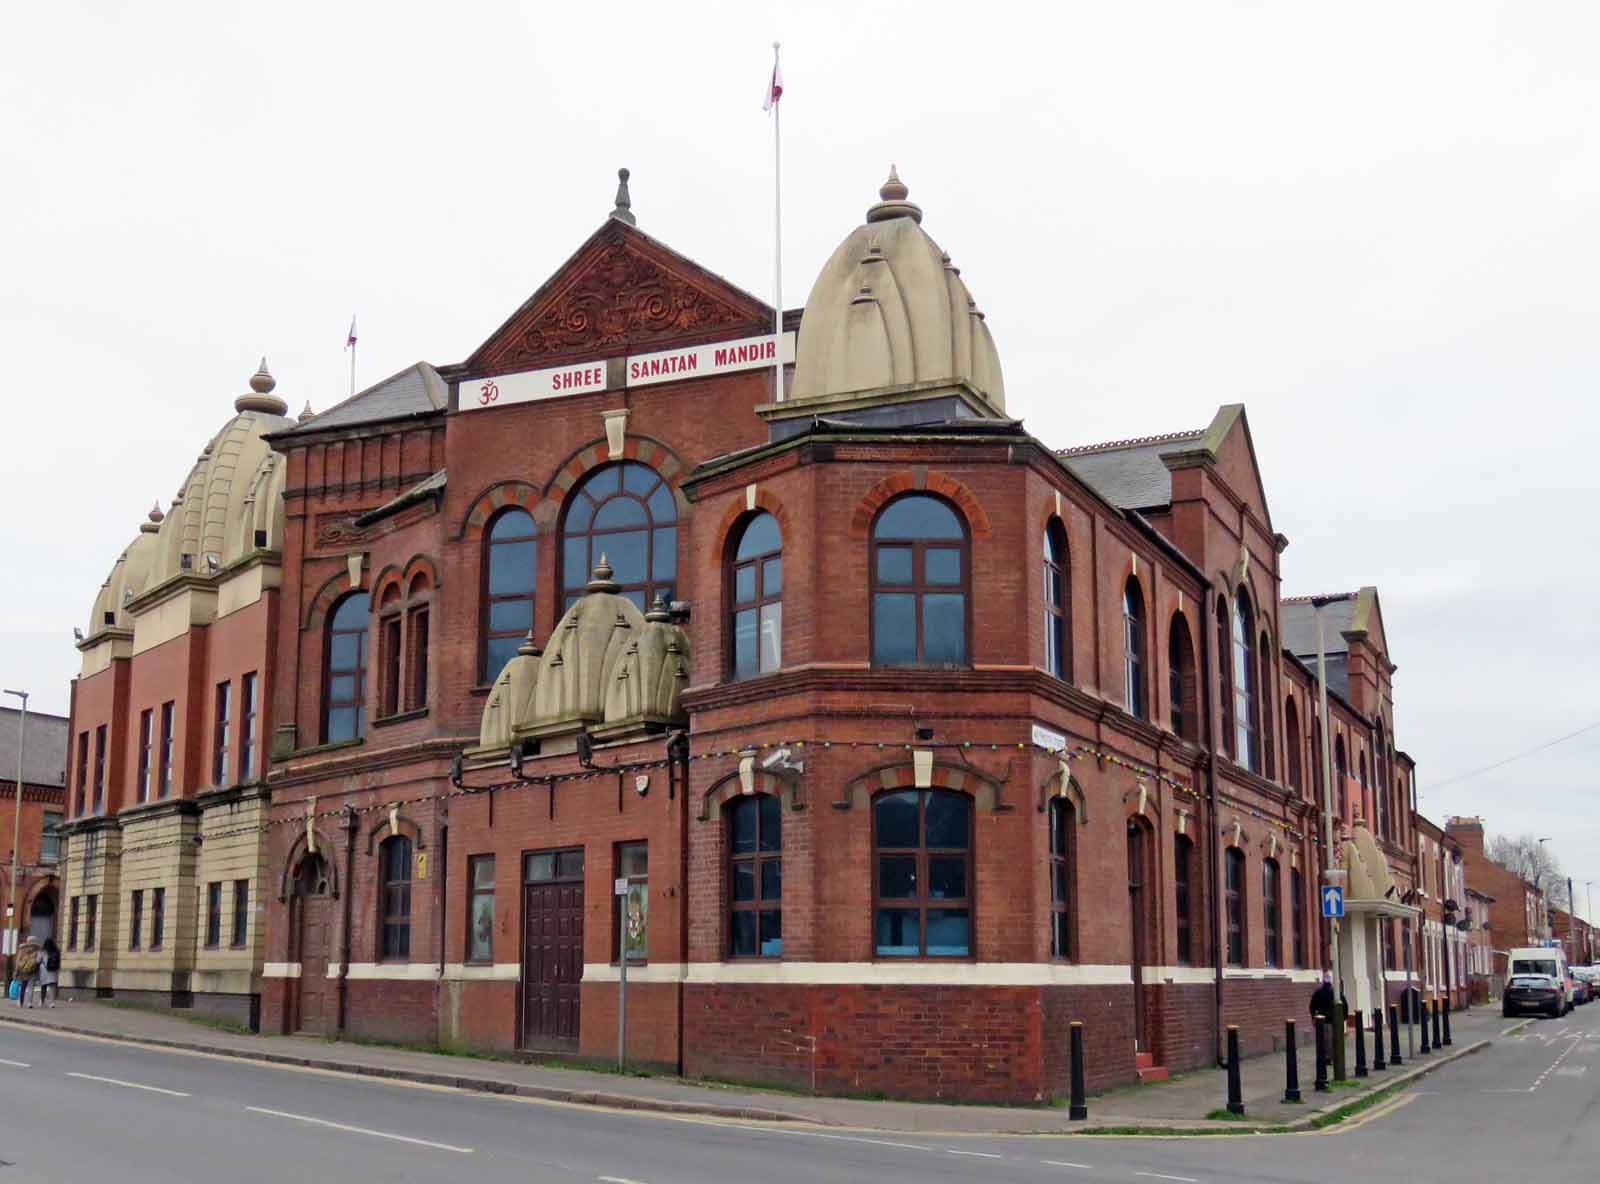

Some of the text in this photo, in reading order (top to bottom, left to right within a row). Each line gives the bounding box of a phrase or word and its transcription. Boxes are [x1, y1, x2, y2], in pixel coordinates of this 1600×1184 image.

[552, 341, 776, 390] SHREE SANATAN MANDIR
